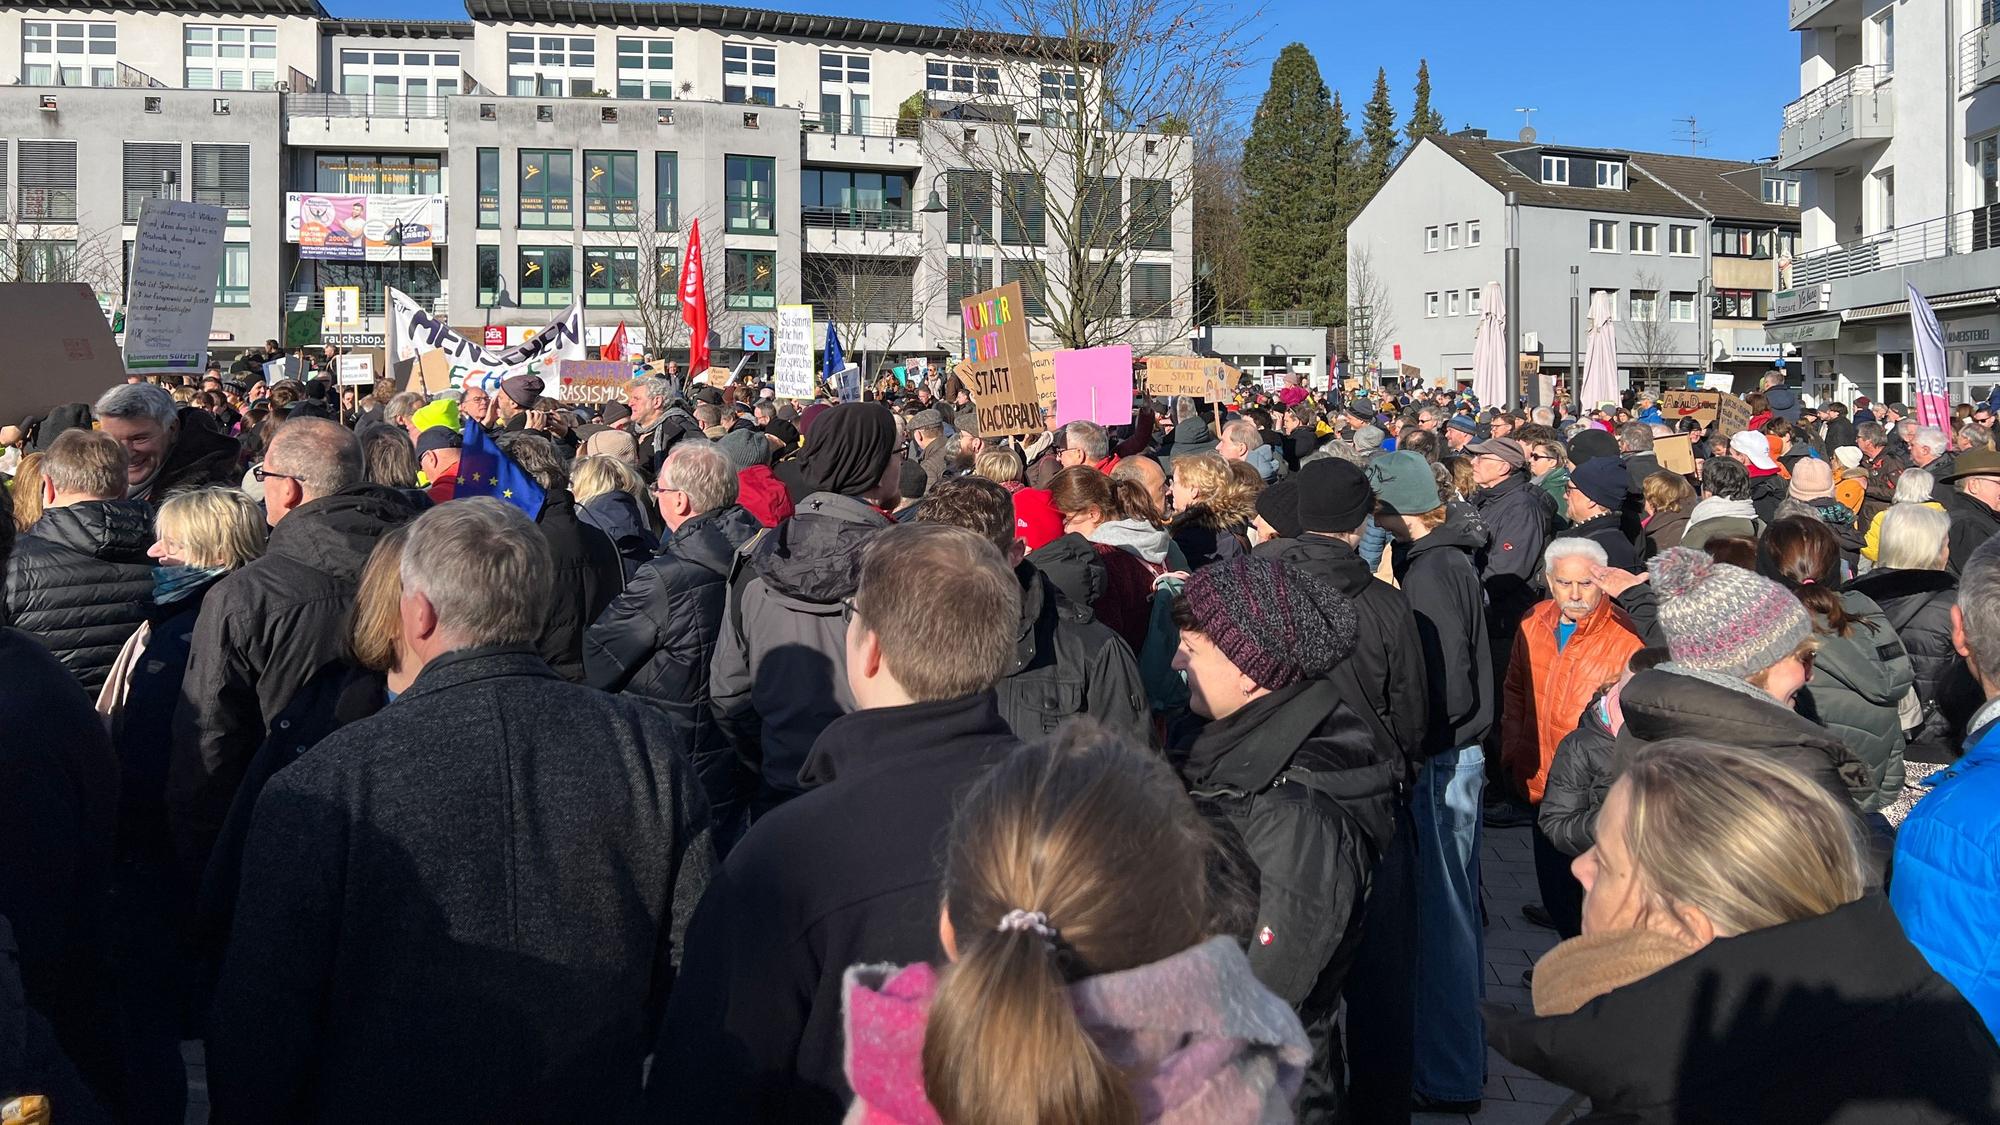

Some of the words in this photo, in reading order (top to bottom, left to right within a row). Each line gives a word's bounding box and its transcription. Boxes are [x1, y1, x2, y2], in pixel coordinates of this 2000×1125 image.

[962, 295, 1012, 331] KUNTER
[969, 331, 999, 363] BUNT
[975, 367, 1011, 396] STATT
[1171, 371, 1194, 381] STATT
[559, 384, 630, 403] RASSISMUS
[977, 402, 1045, 433] KACKBRAUN
